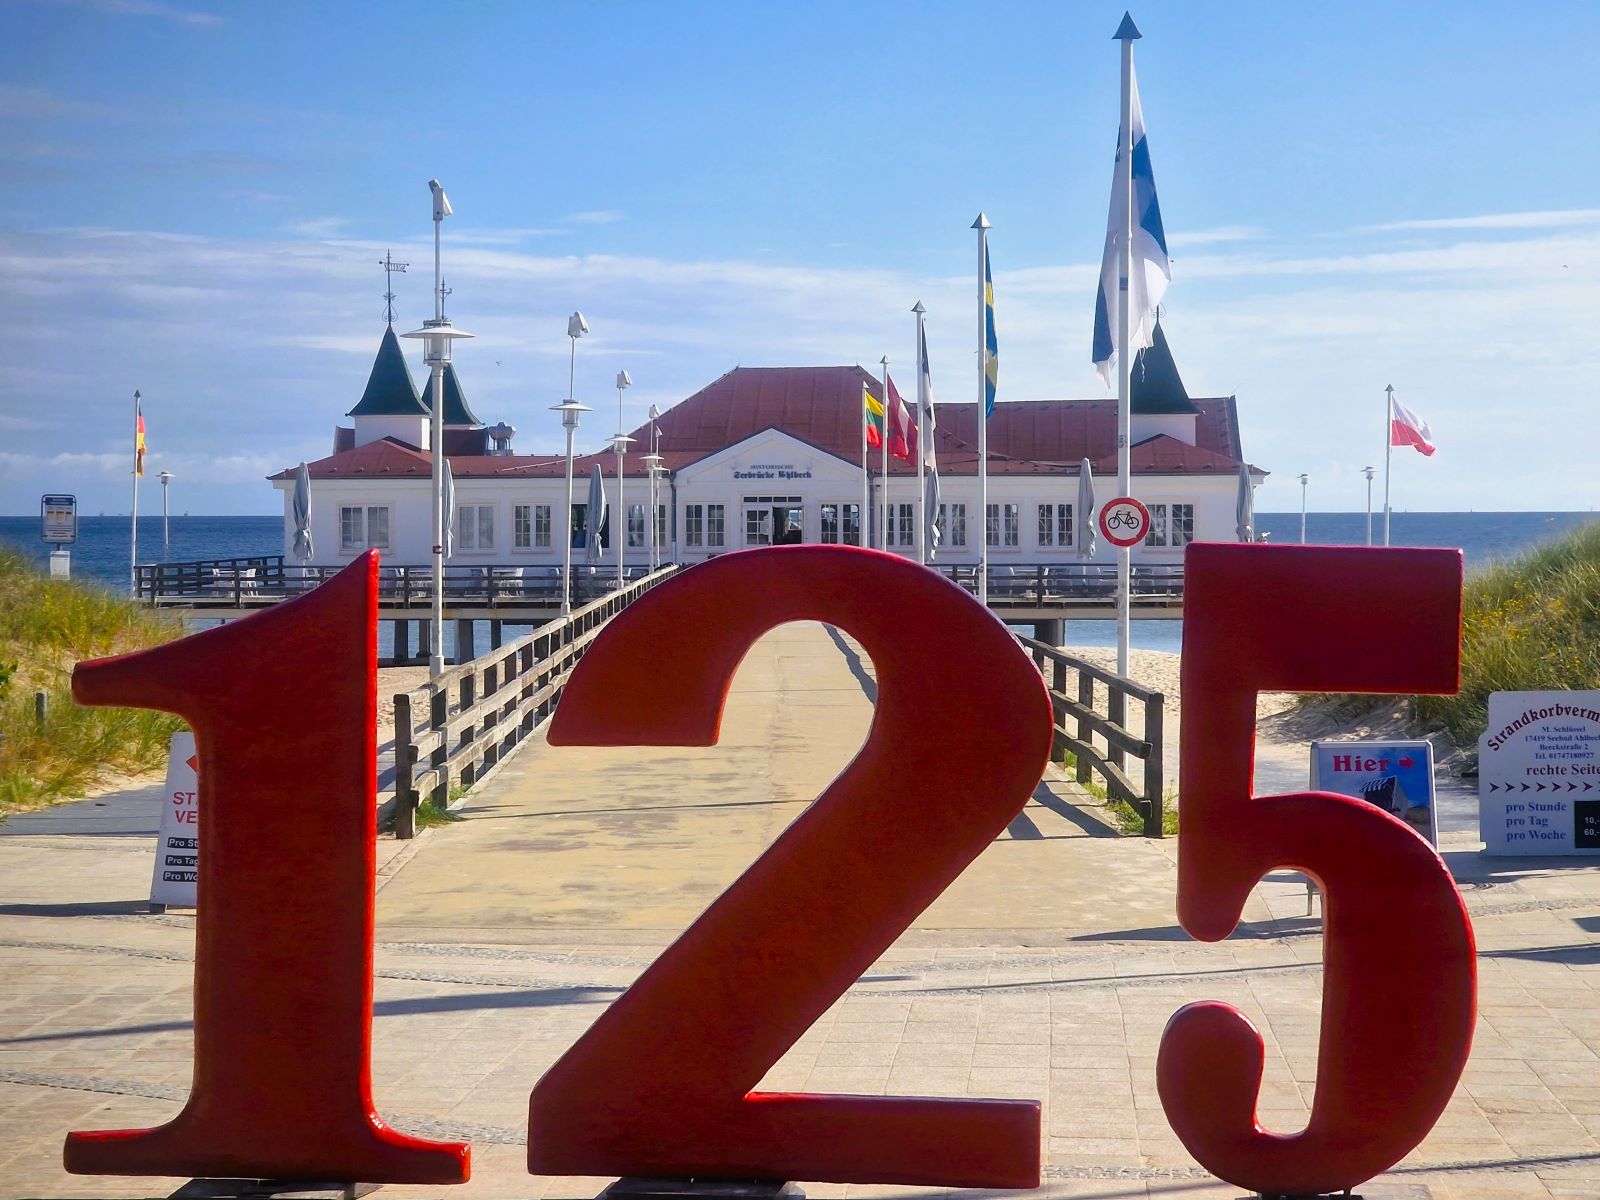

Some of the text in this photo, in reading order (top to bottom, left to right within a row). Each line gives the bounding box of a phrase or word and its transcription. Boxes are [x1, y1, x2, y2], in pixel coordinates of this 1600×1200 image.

[734, 471, 774, 479] Seebrücke
[1487, 703, 1600, 752] Strandkorbverm
[1547, 734, 1573, 742] Seebad
[1333, 755, 1391, 772] Hier
[1526, 764, 1568, 776] rechte
[1505, 801, 1567, 815] pro Stunde
[1506, 815, 1549, 829] pro Tag
[1506, 830, 1566, 843] pro Woche
[168, 838, 185, 848] Pro
[64, 541, 1478, 1193] 125
[166, 856, 183, 866] Pro
[164, 872, 181, 881] Pro
